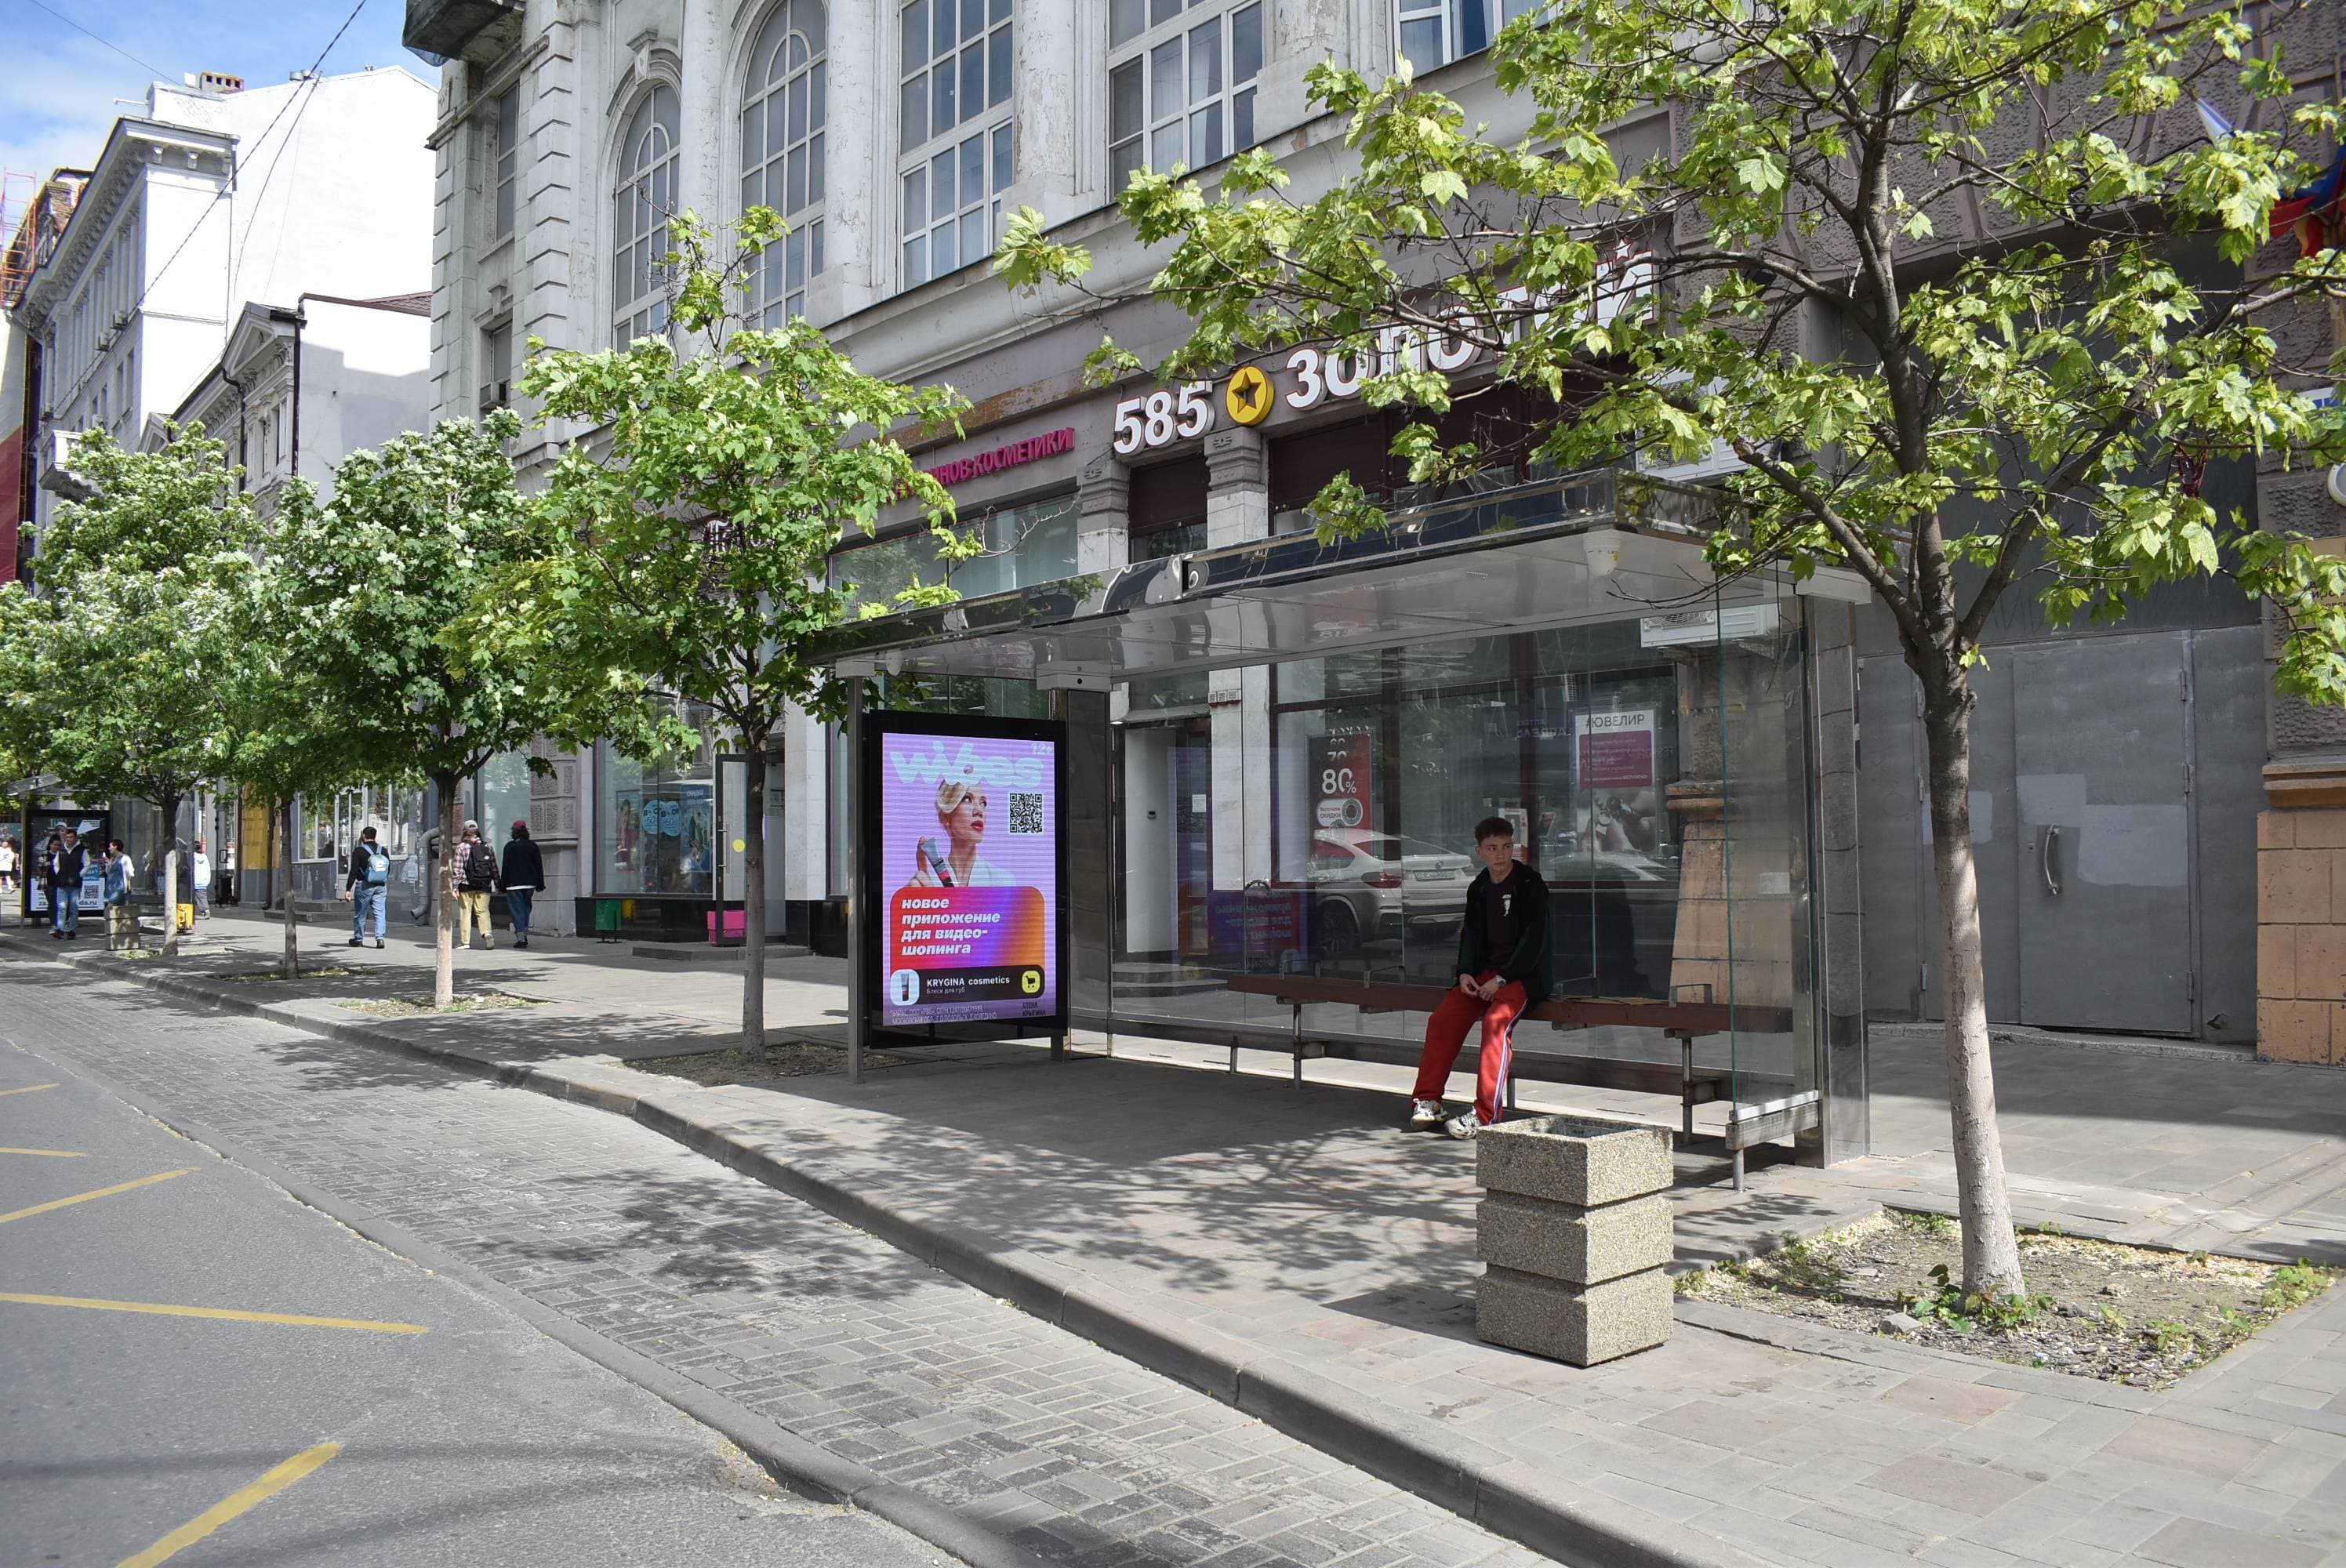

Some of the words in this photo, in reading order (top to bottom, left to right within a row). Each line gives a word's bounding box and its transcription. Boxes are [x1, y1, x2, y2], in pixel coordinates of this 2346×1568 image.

[1113, 380, 1213, 456] 585
[972, 426, 1075, 478] КОСМЕТИКИ
[902, 898, 950, 909] новое
[902, 913, 1000, 928] приложение
[901, 930, 932, 942] для
[935, 928, 988, 941] видео-
[902, 944, 971, 956] шопинга
[927, 978, 964, 987] KRYGINA
[968, 976, 1010, 985] cosmetics
